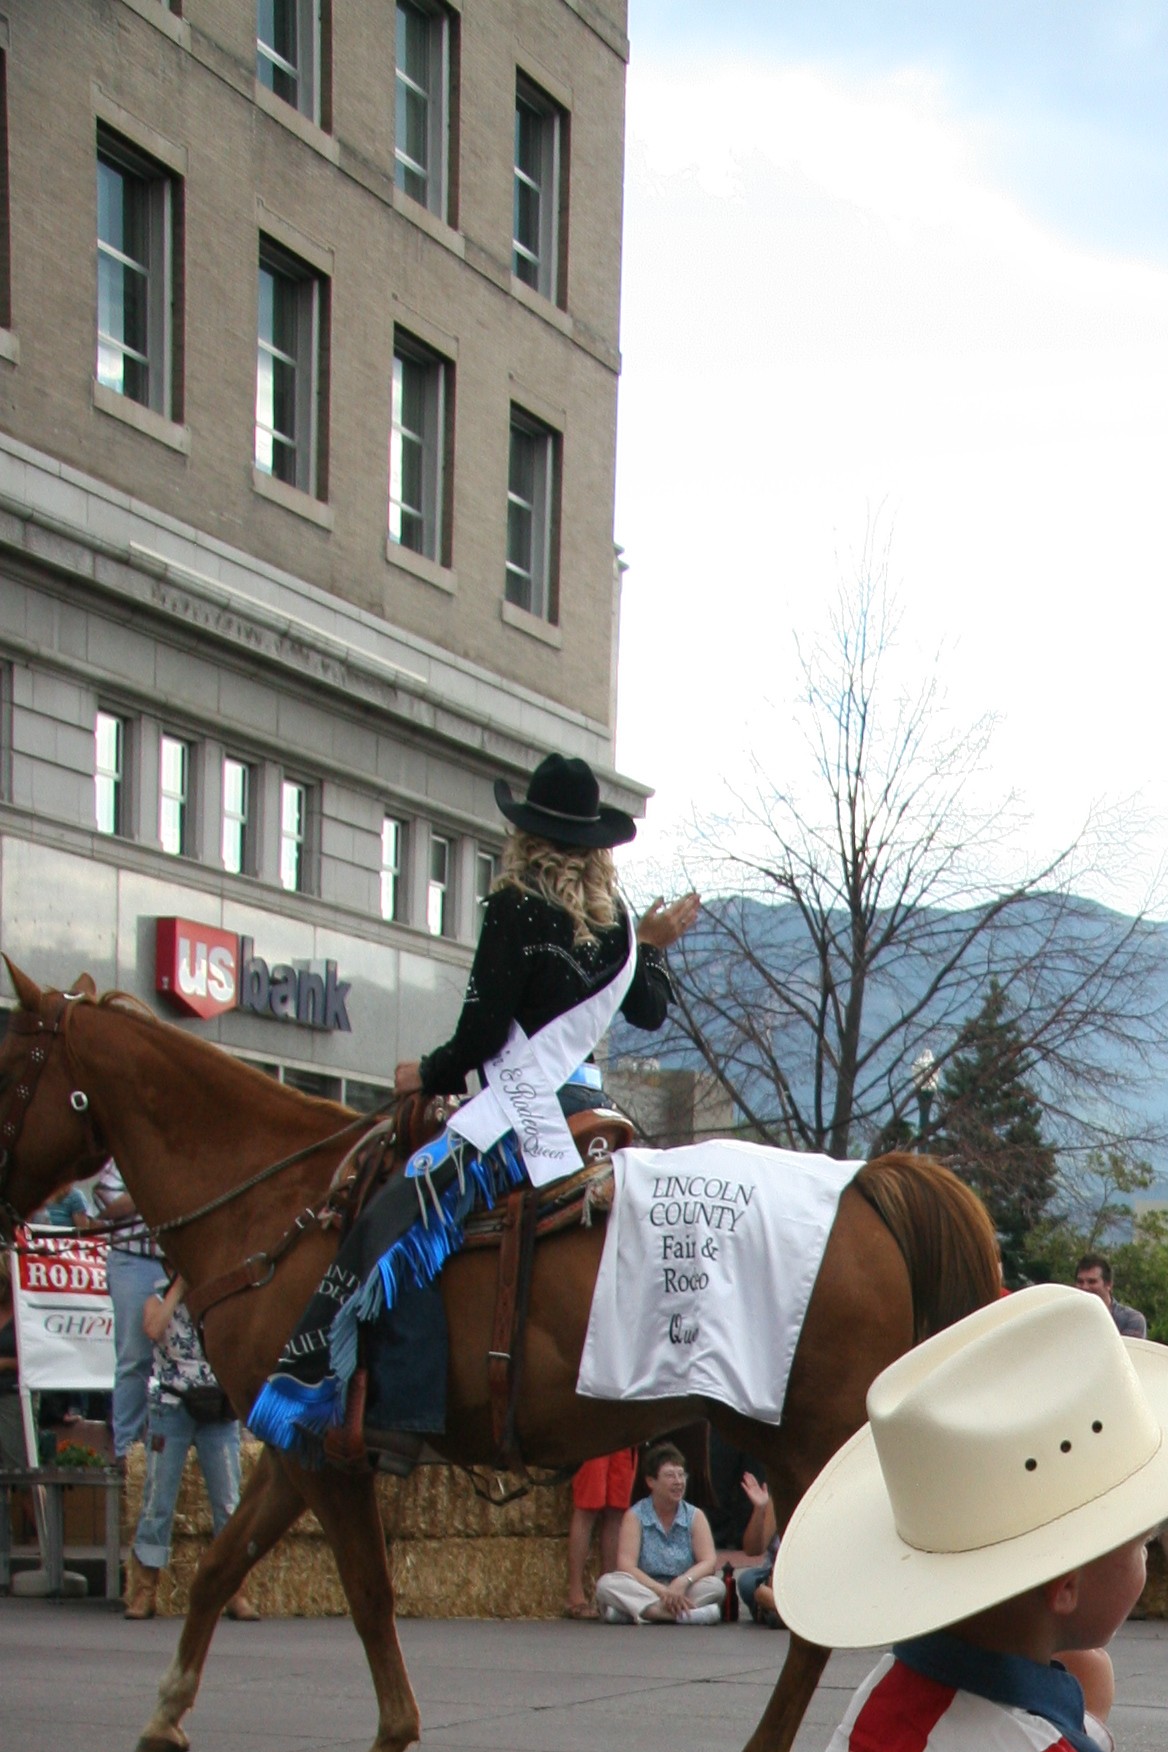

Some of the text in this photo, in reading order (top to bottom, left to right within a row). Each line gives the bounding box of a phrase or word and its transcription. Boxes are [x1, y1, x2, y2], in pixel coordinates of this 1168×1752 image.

[240, 934, 352, 1033] bank
[503, 1083, 545, 1136] Rodeo
[524, 1135, 565, 1158] Queen
[652, 1176, 755, 1206] LINCOLN
[650, 1201, 745, 1232] COUNTY
[701, 1237, 719, 1261] &
